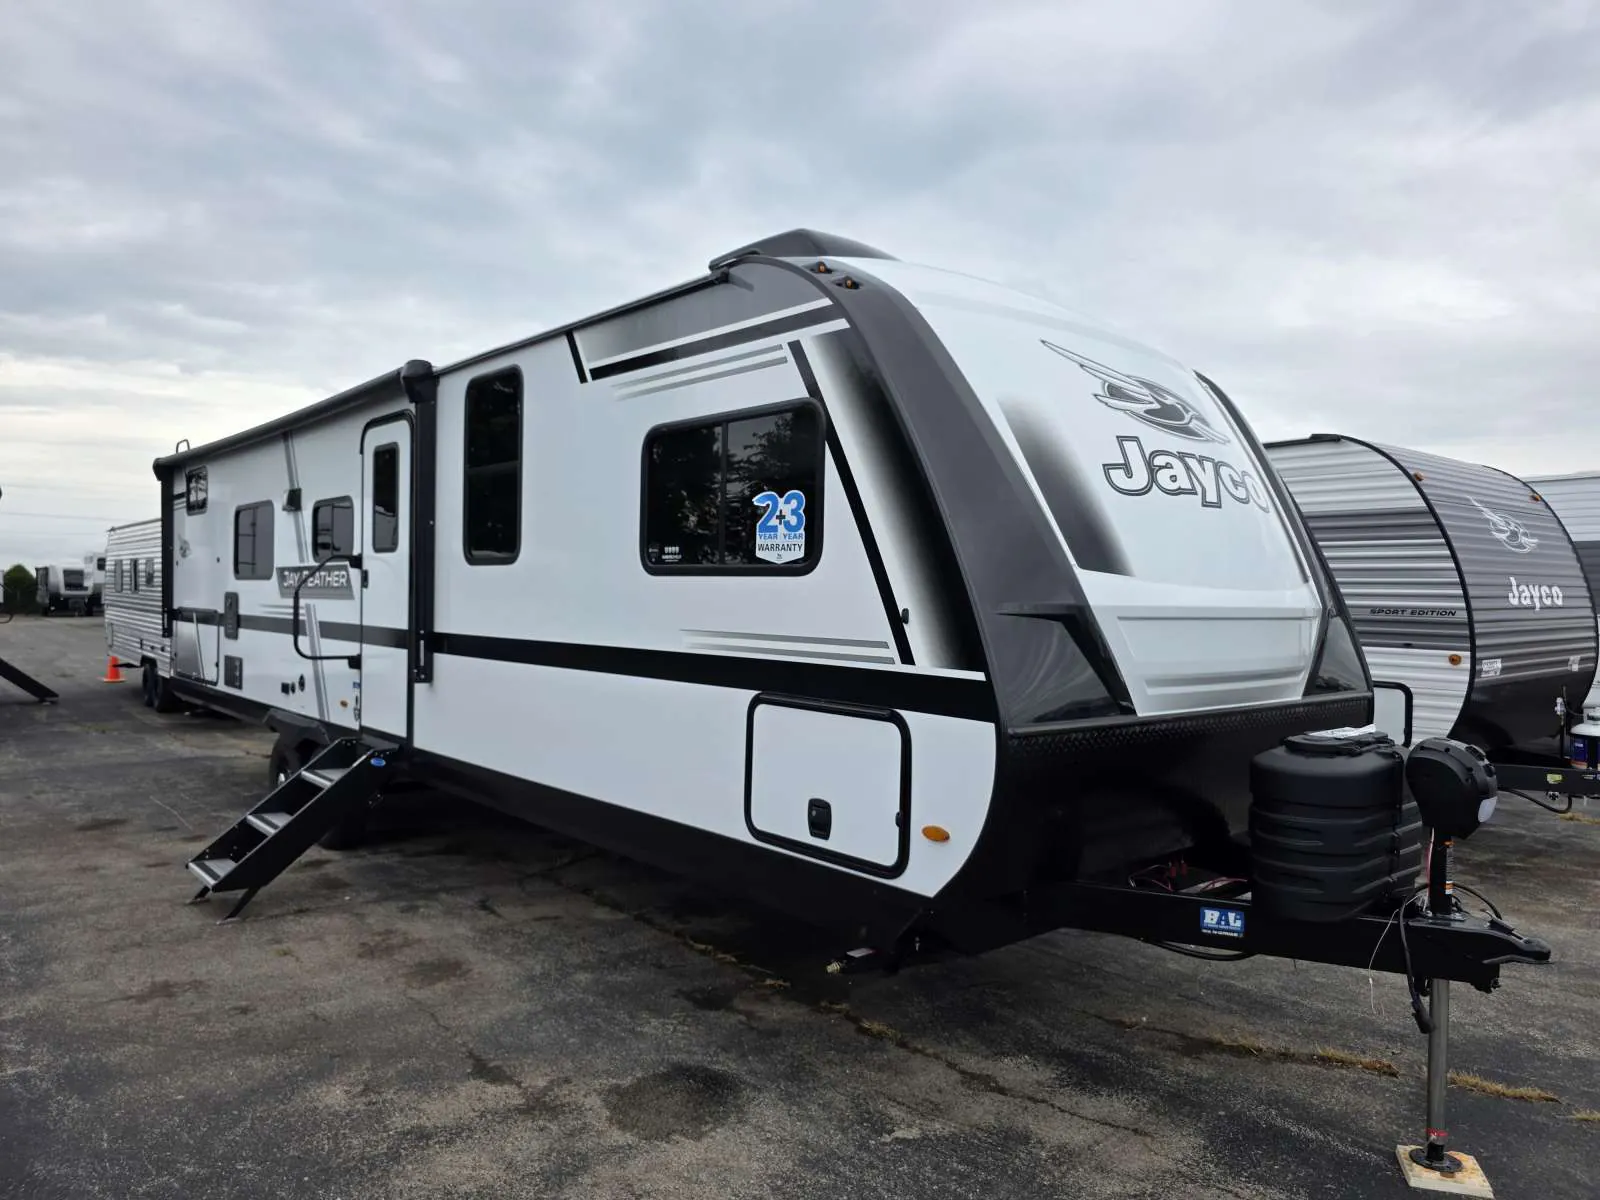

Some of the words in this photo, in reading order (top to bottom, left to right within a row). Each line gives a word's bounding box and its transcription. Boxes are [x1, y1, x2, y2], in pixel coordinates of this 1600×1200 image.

[1102, 435, 1270, 513] Jayco
[783, 532, 804, 540] YEAR
[757, 543, 803, 552] WARRANTY
[283, 570, 301, 587] JAY
[1508, 576, 1563, 611] Jayco
[1410, 608, 1457, 617] EDITION
